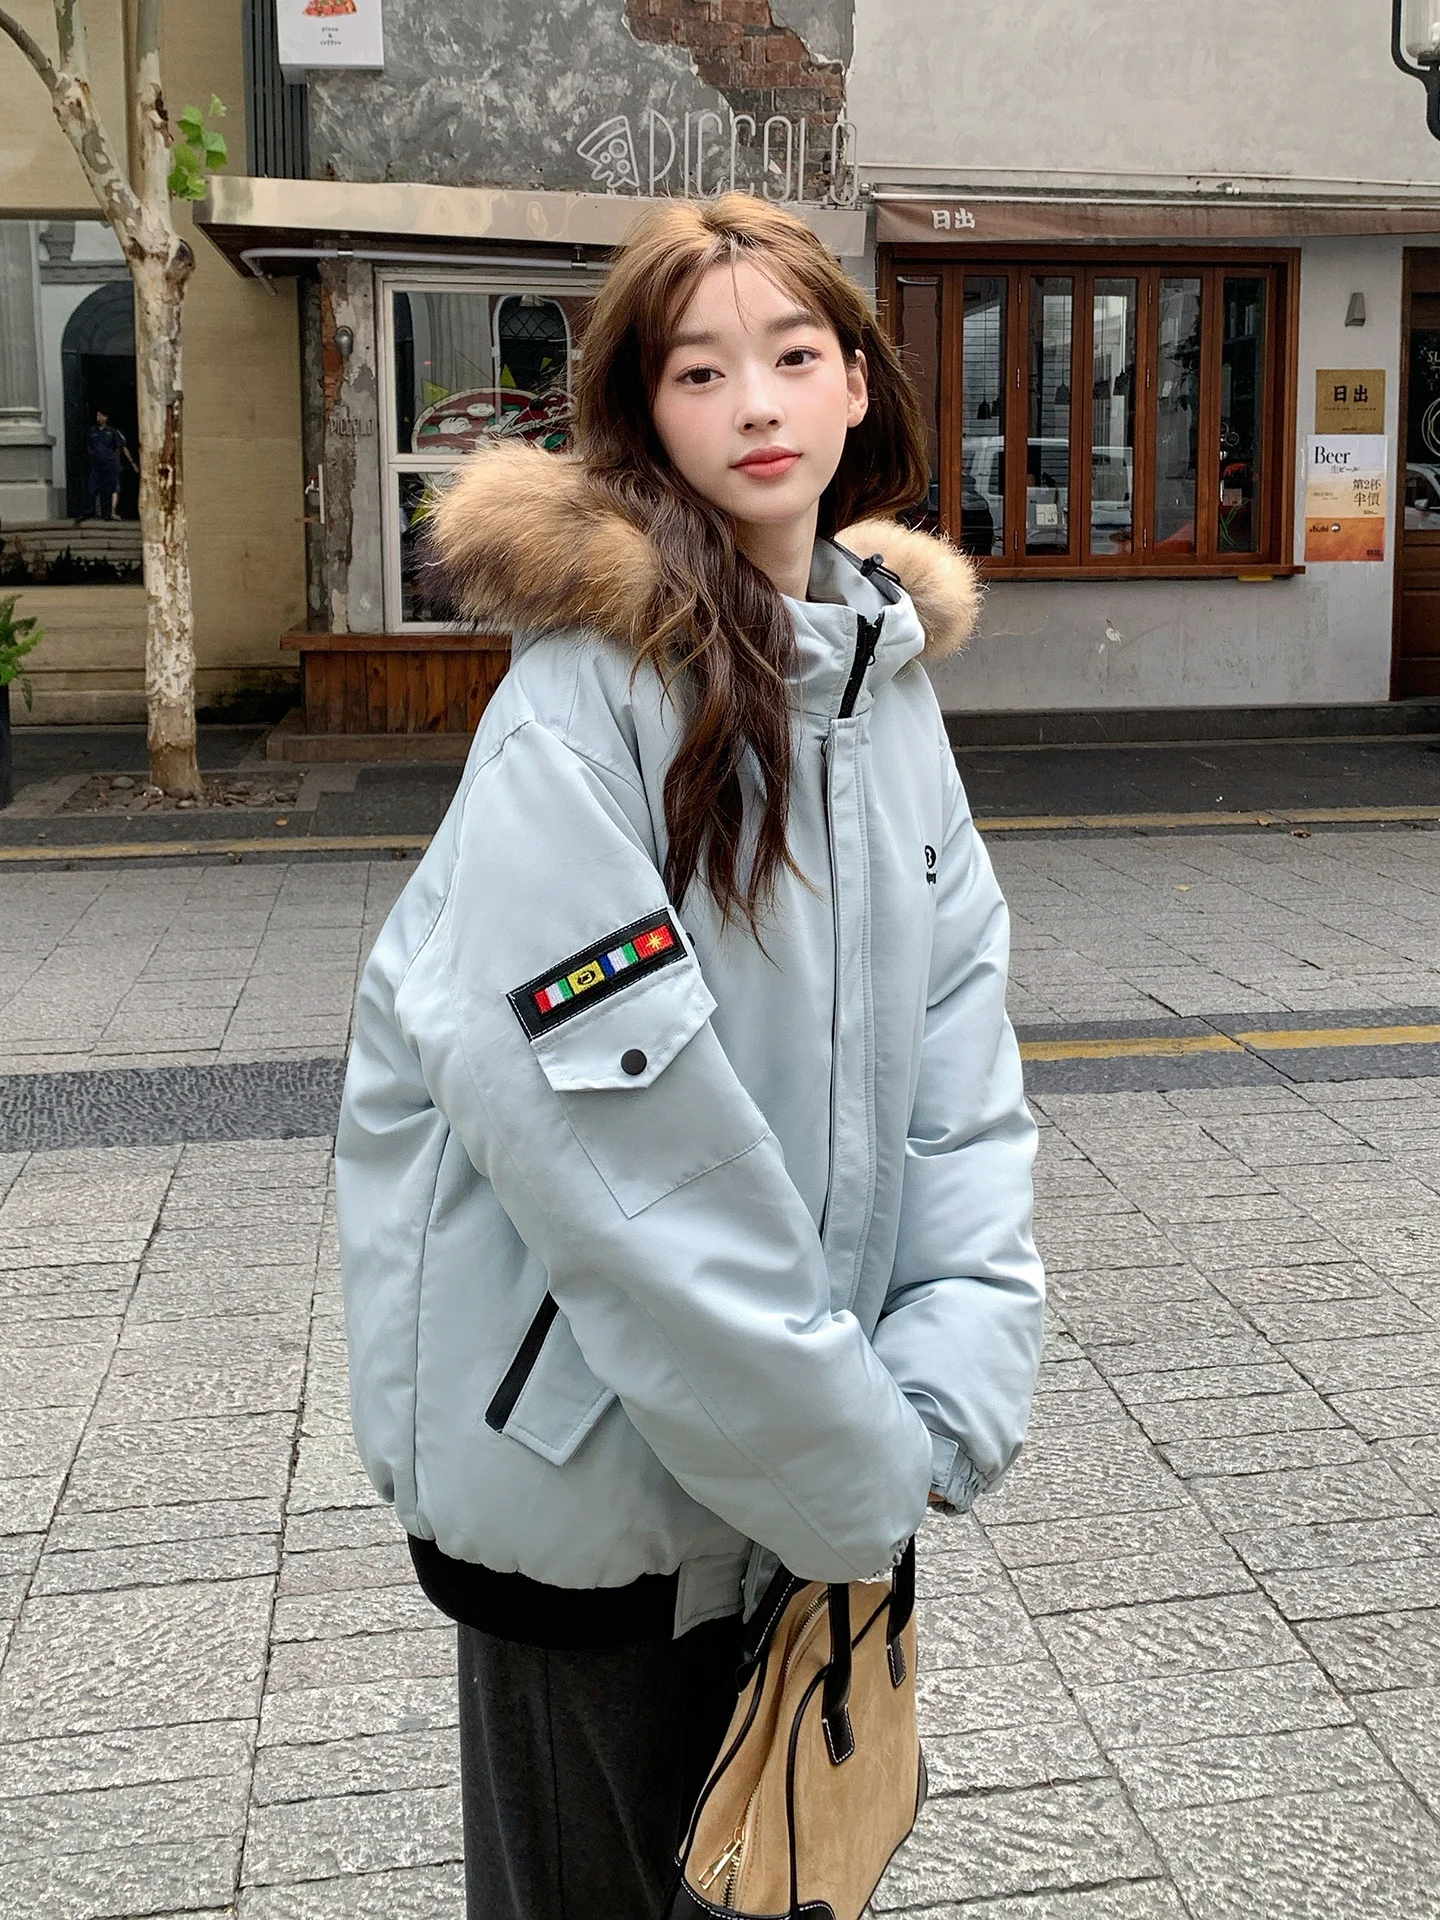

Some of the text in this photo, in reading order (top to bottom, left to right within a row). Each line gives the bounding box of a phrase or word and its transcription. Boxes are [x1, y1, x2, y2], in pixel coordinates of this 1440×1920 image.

[931, 207, 976, 230] 日出
[1333, 384, 1369, 403] 日出
[1314, 445, 1351, 465] Beer
